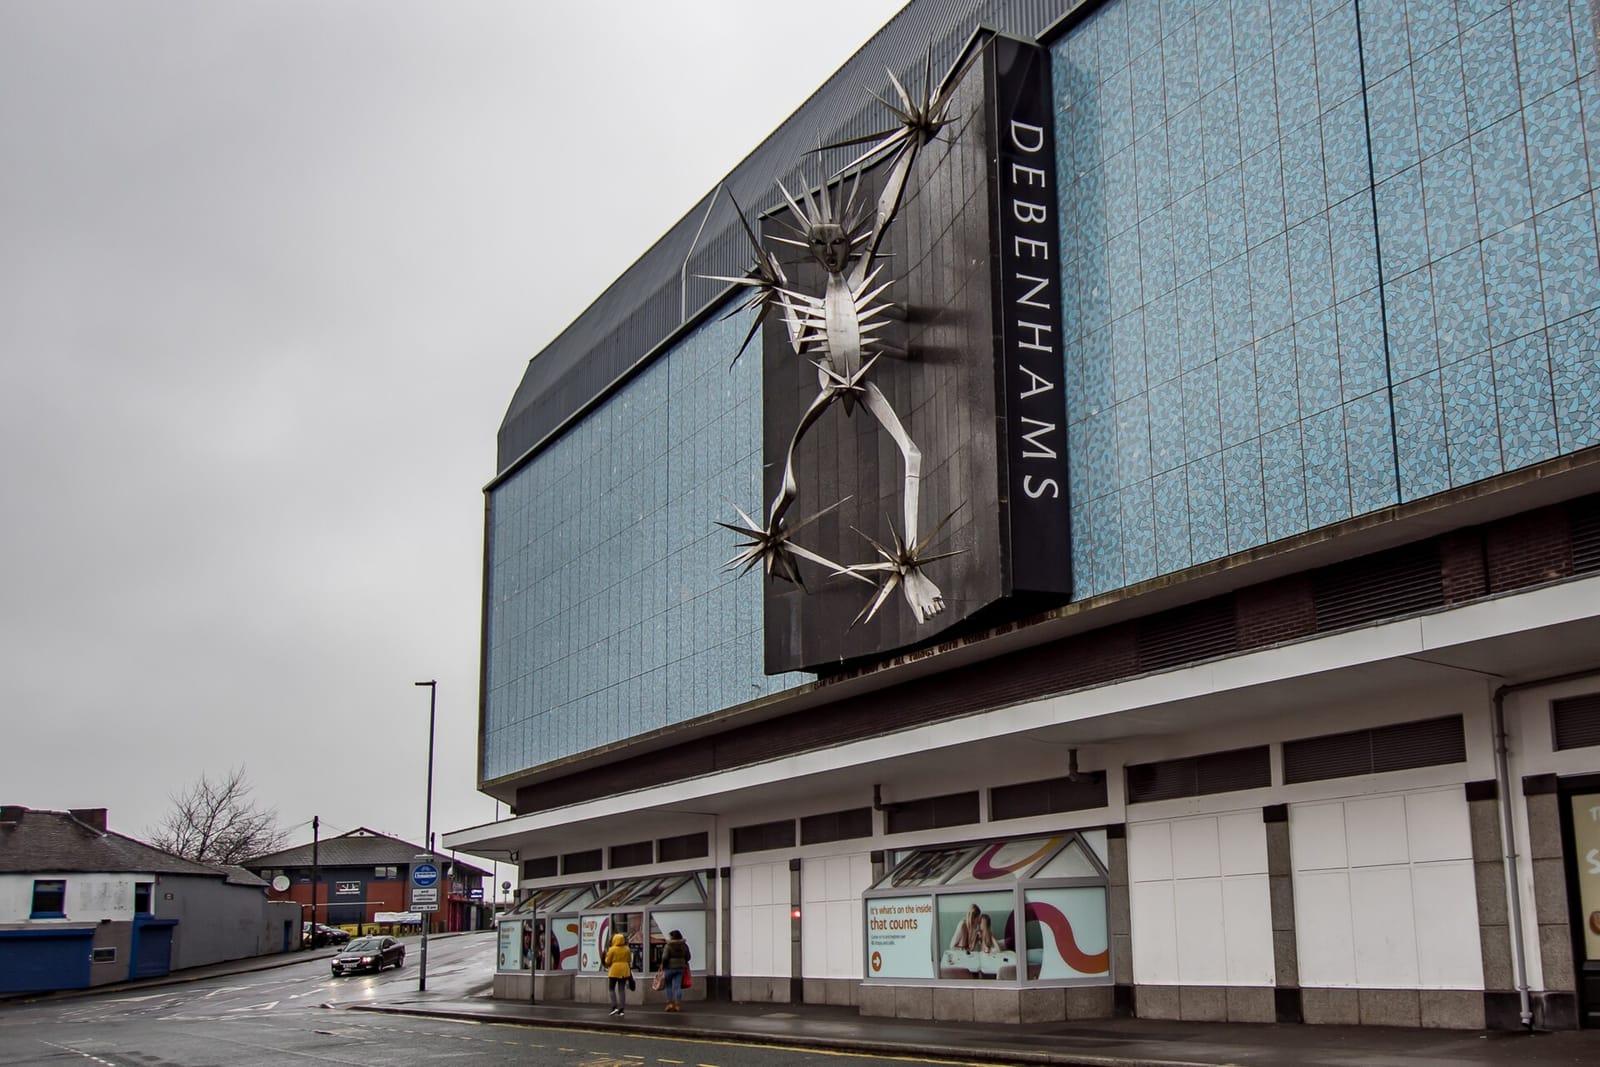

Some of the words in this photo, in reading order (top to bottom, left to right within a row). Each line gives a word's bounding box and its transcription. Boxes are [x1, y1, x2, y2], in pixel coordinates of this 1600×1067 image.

[1010, 119, 1059, 499] DEBENHAMS
[879, 905, 897, 914] what's
[905, 904, 915, 914] the
[916, 904, 932, 912] inside
[870, 917, 887, 930] that
[889, 918, 918, 930] counts
